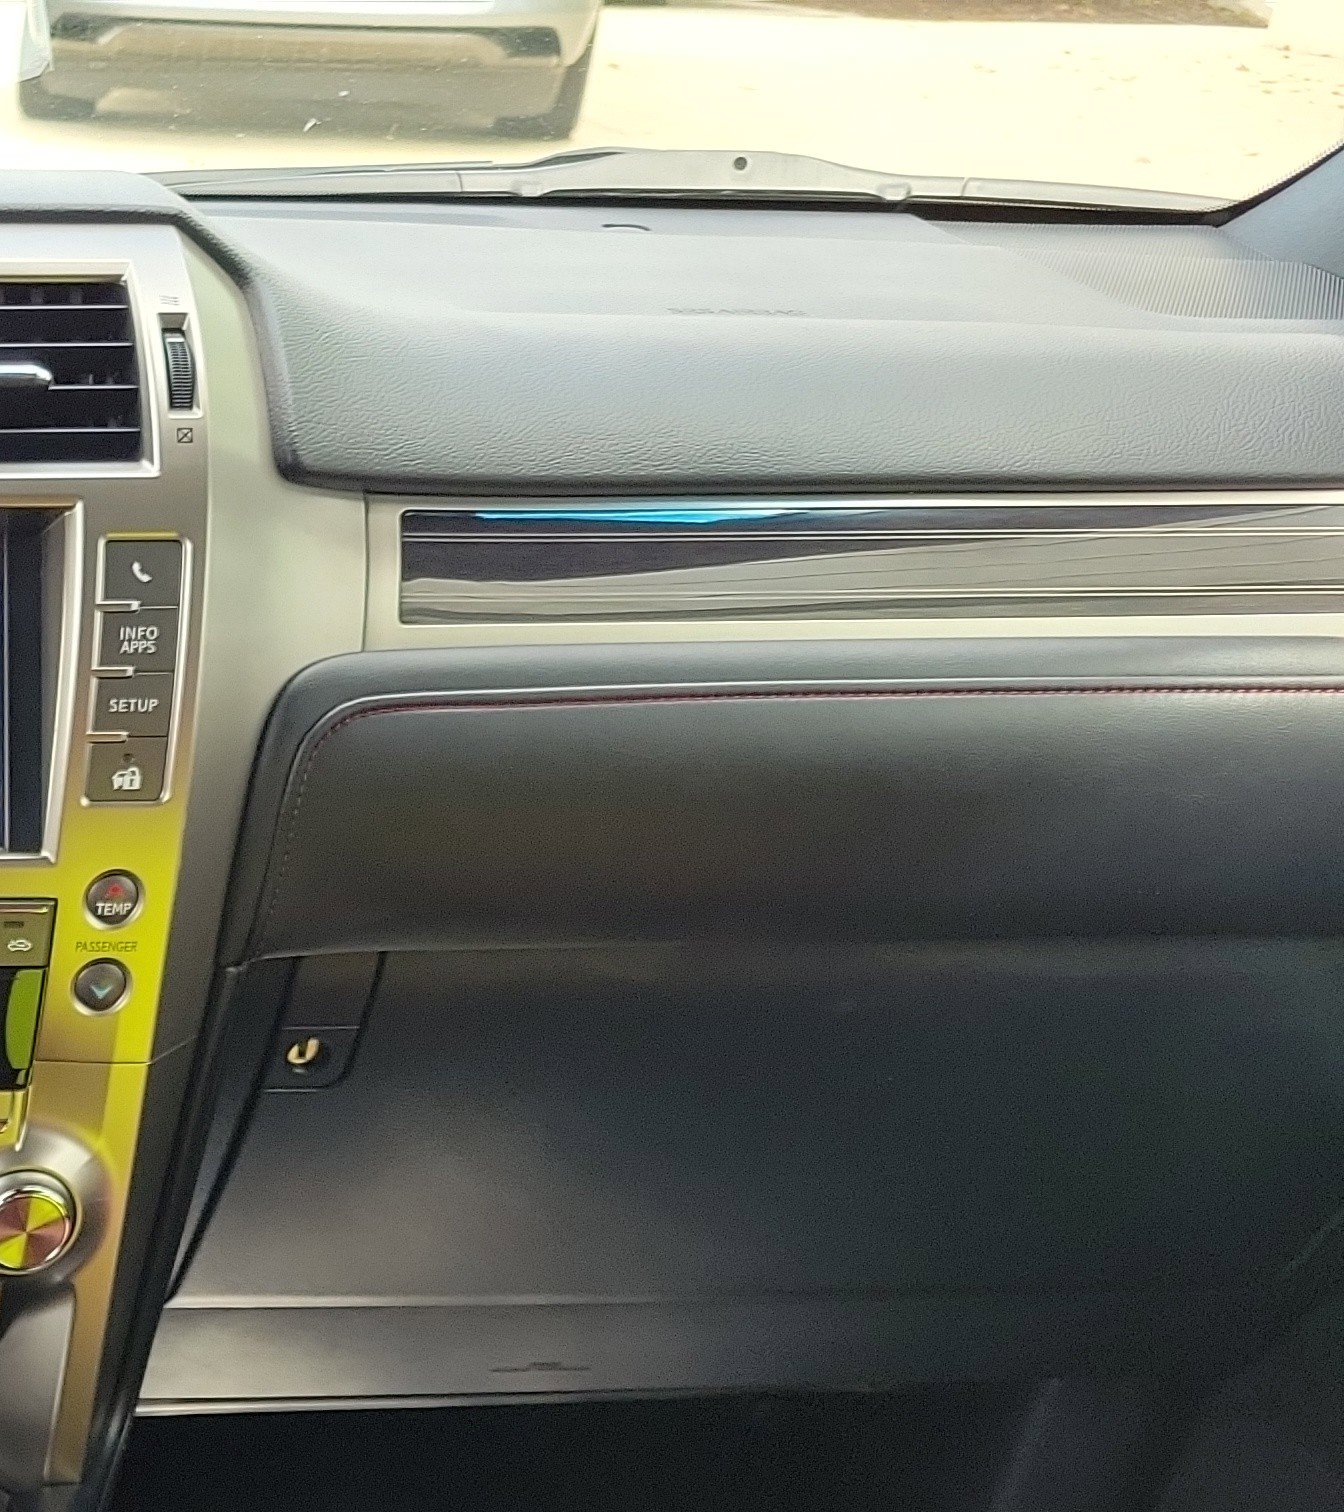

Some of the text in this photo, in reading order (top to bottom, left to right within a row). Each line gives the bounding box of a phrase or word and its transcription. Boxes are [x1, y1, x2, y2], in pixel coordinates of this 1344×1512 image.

[119, 627, 159, 640] INFO
[119, 640, 157, 654] APPS
[109, 699, 159, 713] SETUP
[95, 902, 133, 916] TEMP
[75, 941, 138, 952] PASSENGER
